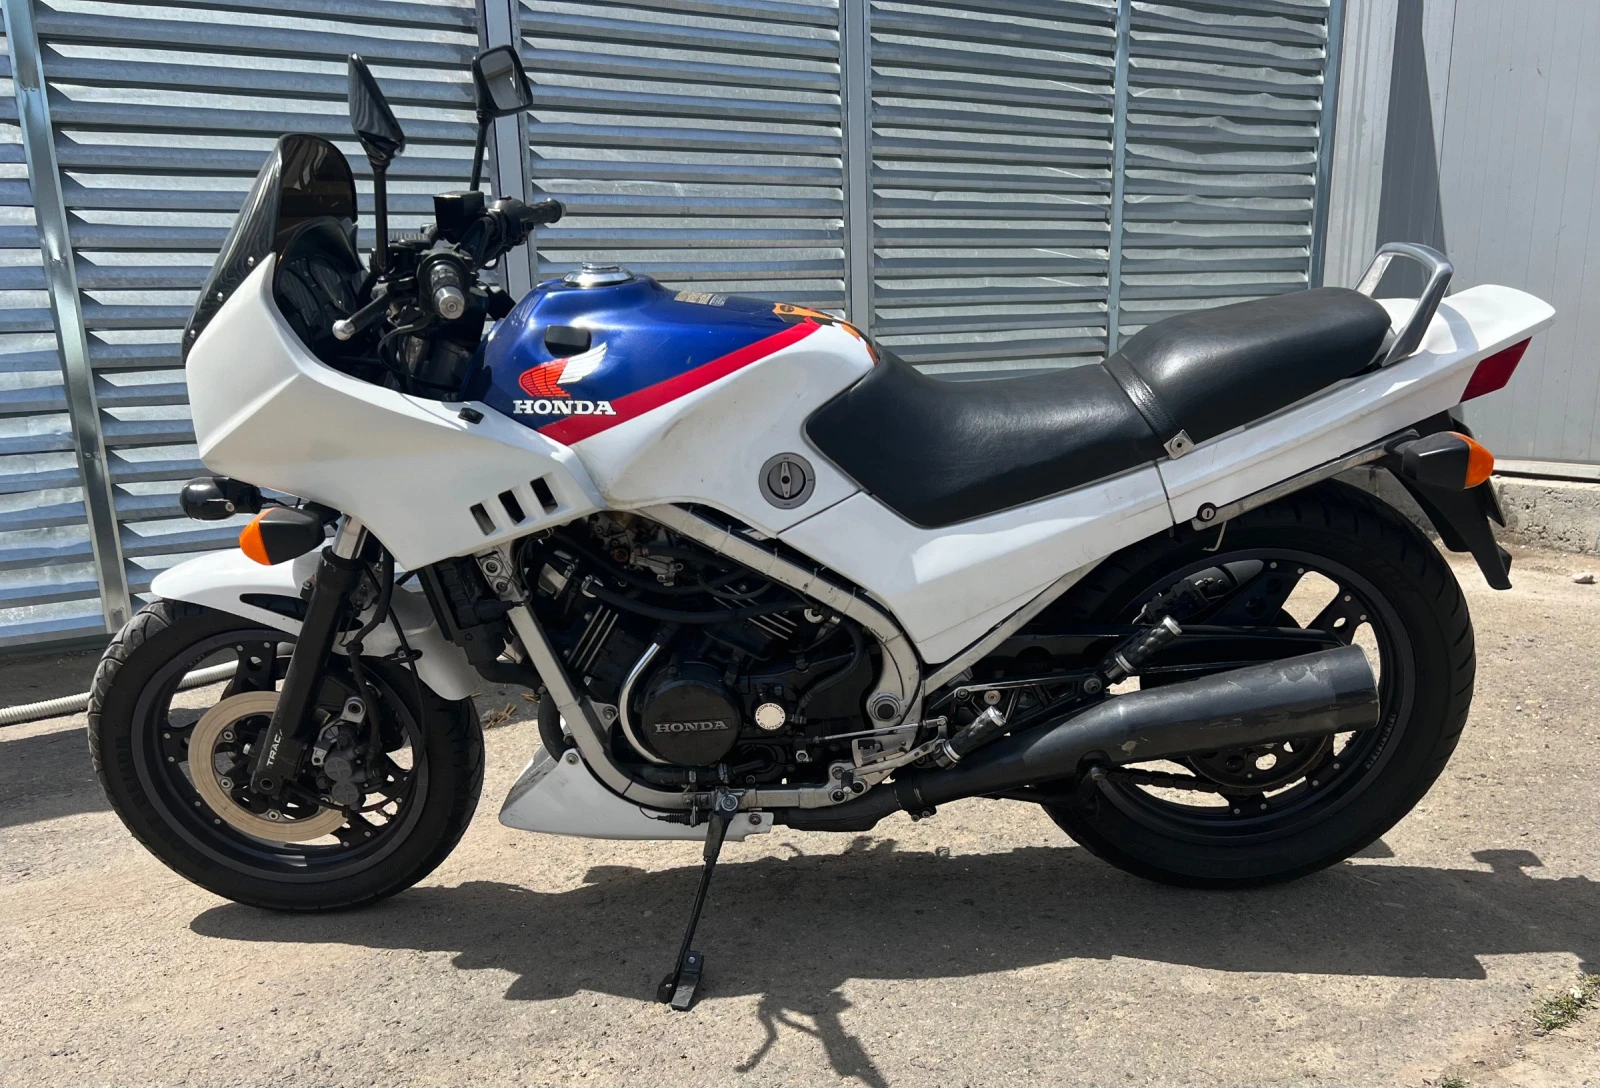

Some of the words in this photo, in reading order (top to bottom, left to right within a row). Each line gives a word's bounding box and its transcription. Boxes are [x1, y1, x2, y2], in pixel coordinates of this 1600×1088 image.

[513, 399, 617, 415] HONDA
[757, 703, 784, 716] HYDRAULIC
[655, 720, 728, 733] HONDA
